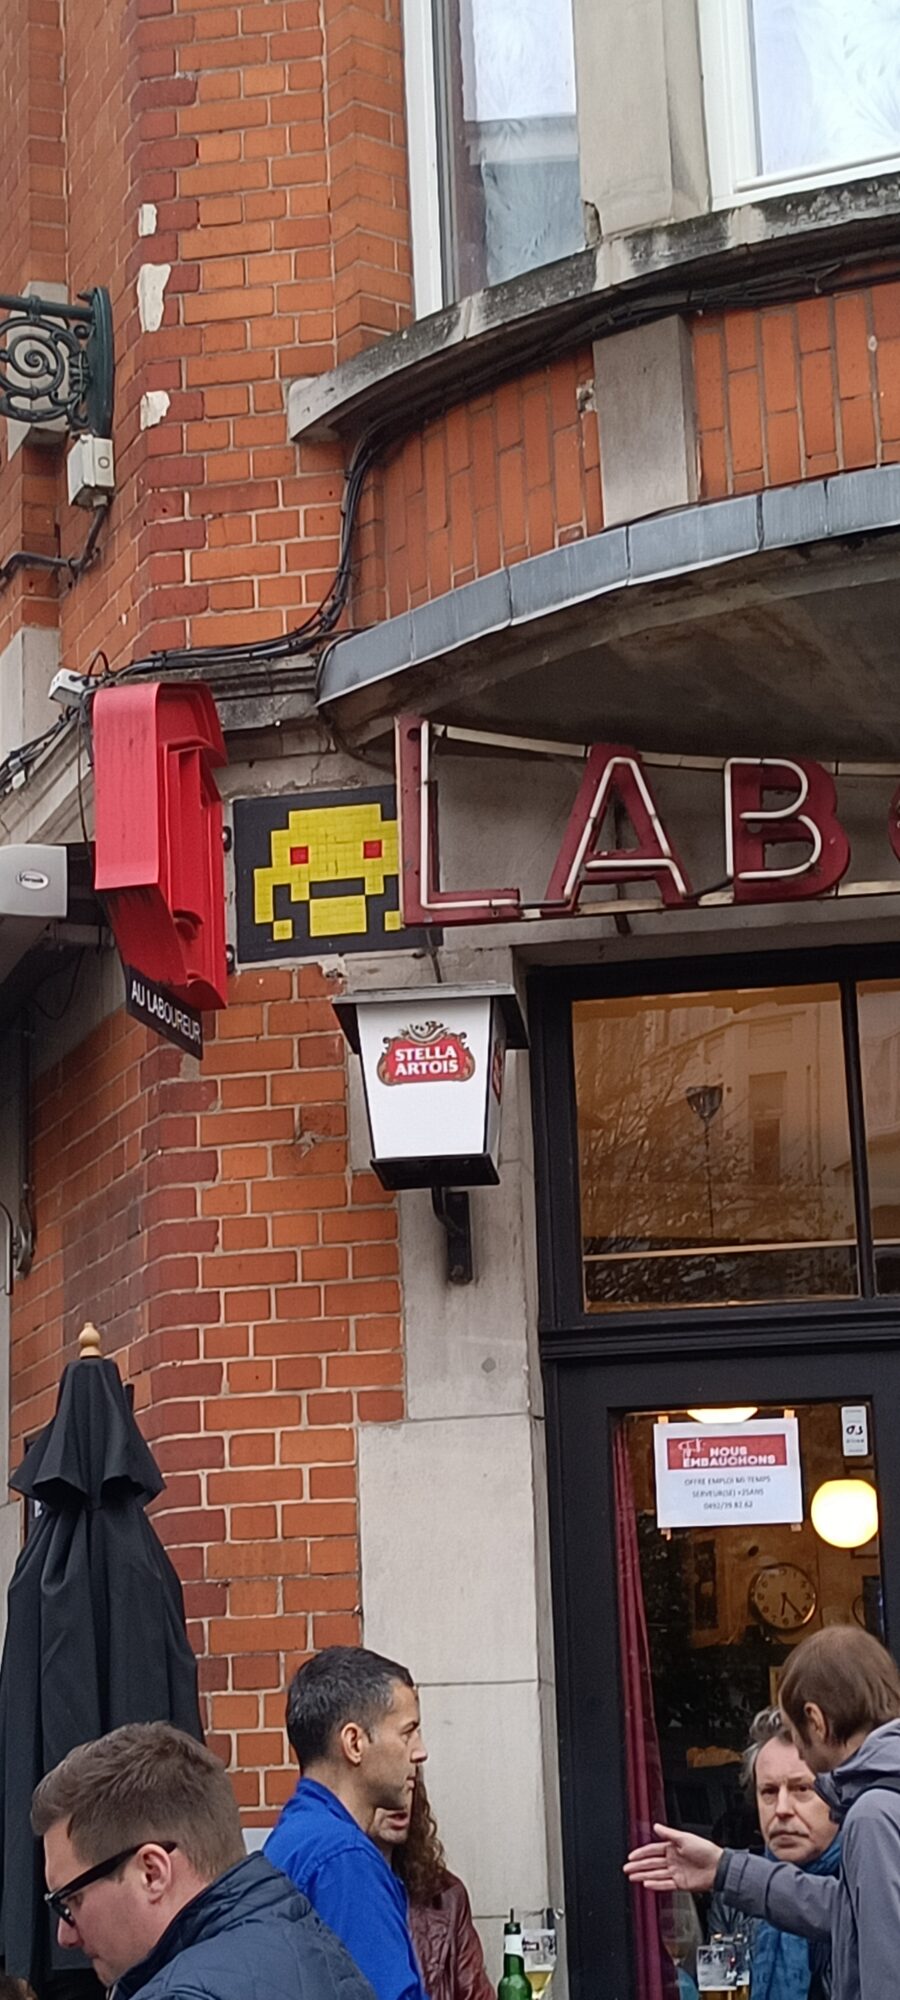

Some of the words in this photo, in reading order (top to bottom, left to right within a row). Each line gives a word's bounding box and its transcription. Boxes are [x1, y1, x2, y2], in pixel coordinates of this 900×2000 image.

[395, 715, 900, 927] LAB
[131, 980, 145, 1007] AU
[147, 989, 201, 1044] LABOUREUR
[394, 1045, 457, 1061] STELLA
[395, 1060, 459, 1076] ARTOIS
[709, 1446, 748, 1457] NOUS
[682, 1454, 776, 1468] EMBAUCHONS
[684, 1478, 706, 1486] OFFRE
[708, 1477, 734, 1486] EMPLOI
[747, 1475, 771, 1484] TEMPS
